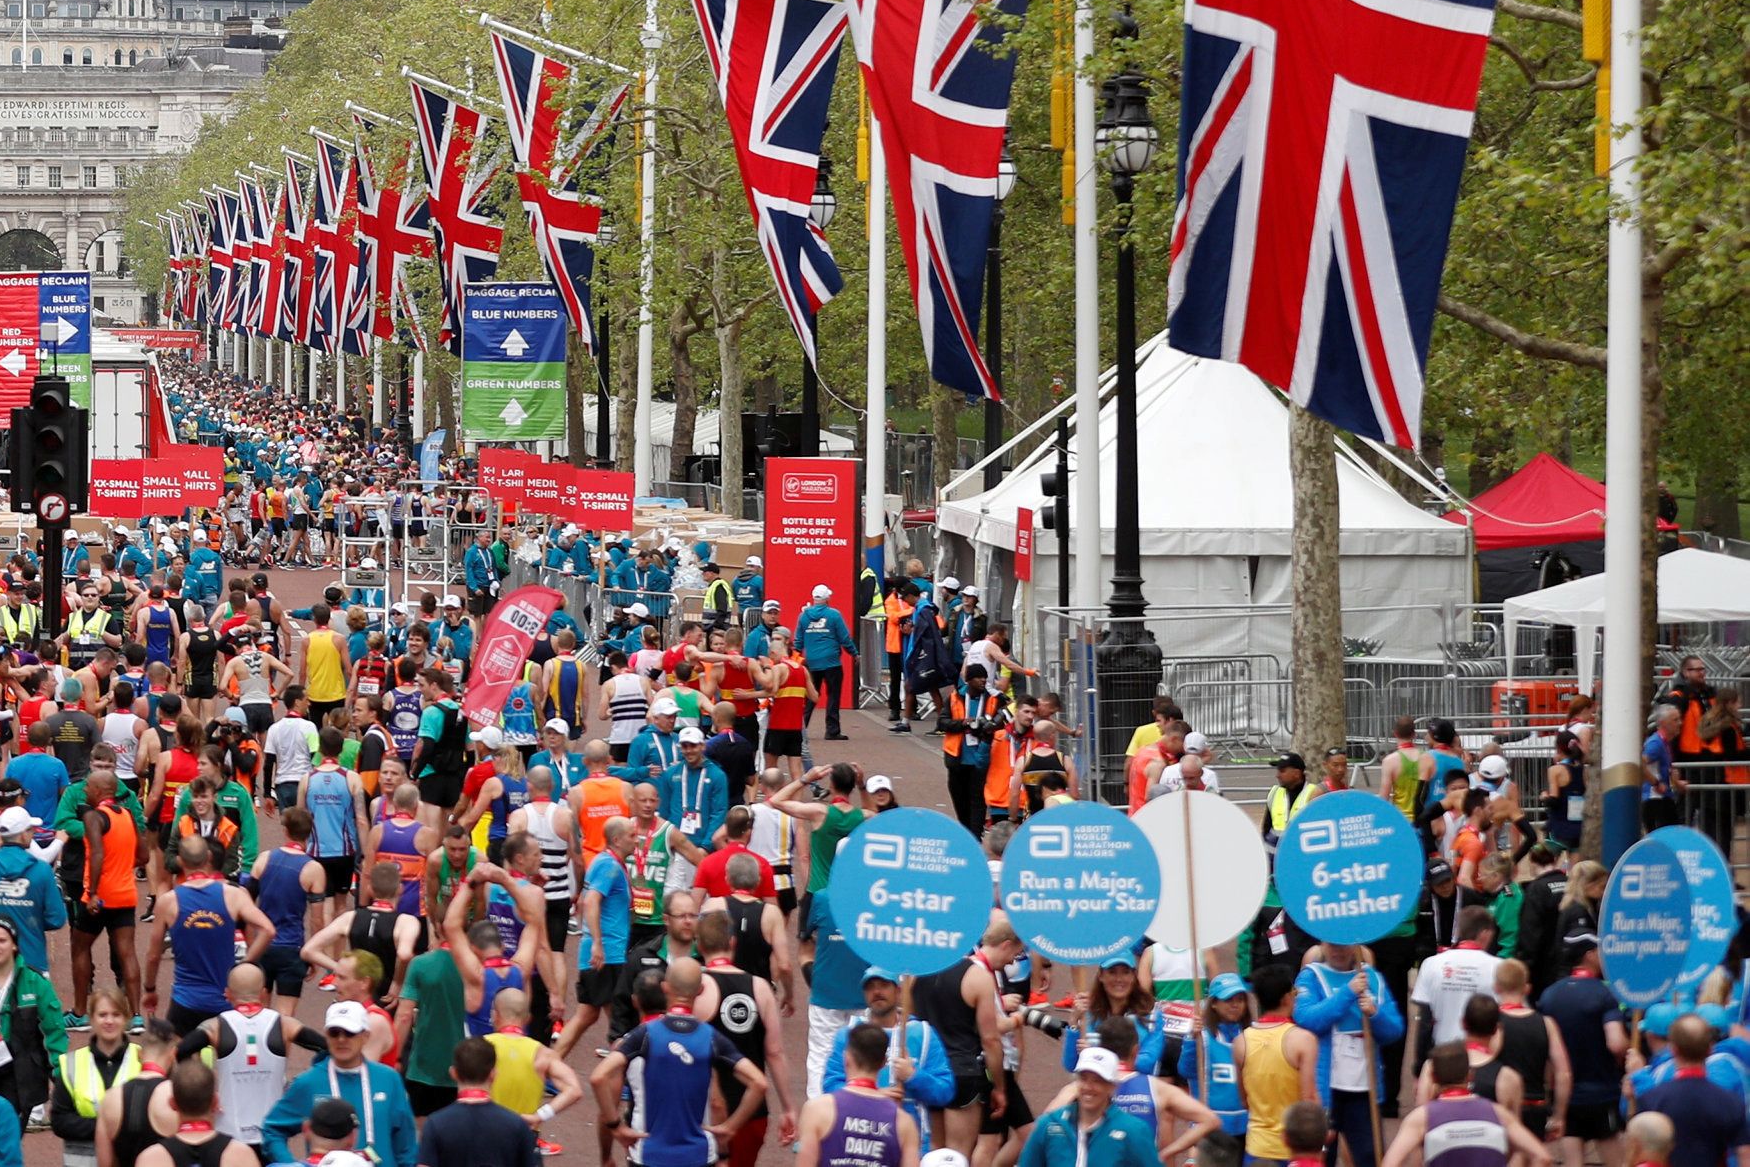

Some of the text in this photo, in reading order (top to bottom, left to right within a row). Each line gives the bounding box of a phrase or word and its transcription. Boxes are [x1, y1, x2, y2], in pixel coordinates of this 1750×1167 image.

[3, 101, 48, 109] EDWARDI
[53, 101, 93, 109] SEPTIMI
[99, 101, 126, 109] REGIS
[1, 111, 32, 119] CIVES
[36, 111, 94, 119] GRATISSIMI
[99, 111, 147, 119] MDCCCCX
[42, 276, 87, 285] RECLAIM
[467, 288, 557, 297] BAGGAGE RECLAI
[52, 295, 77, 303] BLUE
[42, 304, 87, 314] NUMBERS
[472, 310, 558, 319] BLUE NUMBERS
[2, 328, 21, 336] RED
[65, 375, 88, 383] BERS
[466, 380, 562, 389] GREEN NUMBERS
[501, 469, 524, 477] LAR
[94, 479, 140, 489] XX-SMALL
[143, 477, 181, 487] SMALL
[185, 481, 217, 491] HIRTS
[497, 478, 524, 487] T-SHI
[527, 478, 558, 488] MEDI
[96, 488, 138, 498] T-SHIRTS
[143, 488, 182, 498] SHIRTS
[525, 489, 558, 499] T-SHIR
[580, 492, 630, 502] XX-SMALL
[583, 501, 627, 511] T-SHIRTS
[782, 517, 813, 525] BOTTLE
[784, 527, 807, 535] DROP
[794, 537, 847, 546] COLLECTION
[795, 547, 821, 555] POINT
[1338, 814, 1375, 826] ABBOTT
[1074, 825, 1113, 834] ABBOTT
[1339, 822, 1371, 833] WORLD
[1074, 833, 1108, 841] WORLD
[1340, 827, 1394, 840] MARATHON
[909, 837, 949, 847] ABBOTT
[1074, 841, 1133, 849] MARATHON
[1340, 837, 1379, 848] MAJORS
[909, 845, 945, 855] WORLD
[908, 853, 968, 866] MARATHON
[907, 863, 949, 873] MAJORS
[1311, 861, 1389, 888] 6-star
[1019, 870, 1144, 897] Run a Major,
[869, 878, 956, 913] 6-star
[3, 897, 34, 907] balance
[1005, 891, 1157, 918] Claim your Star
[1305, 889, 1403, 921] finisher
[1612, 910, 1636, 932] Run
[855, 911, 964, 949] finisher
[1031, 934, 1133, 959] AbbottWMM.com
[1602, 934, 1636, 954] Claim
[845, 1137, 886, 1157] DAVE
